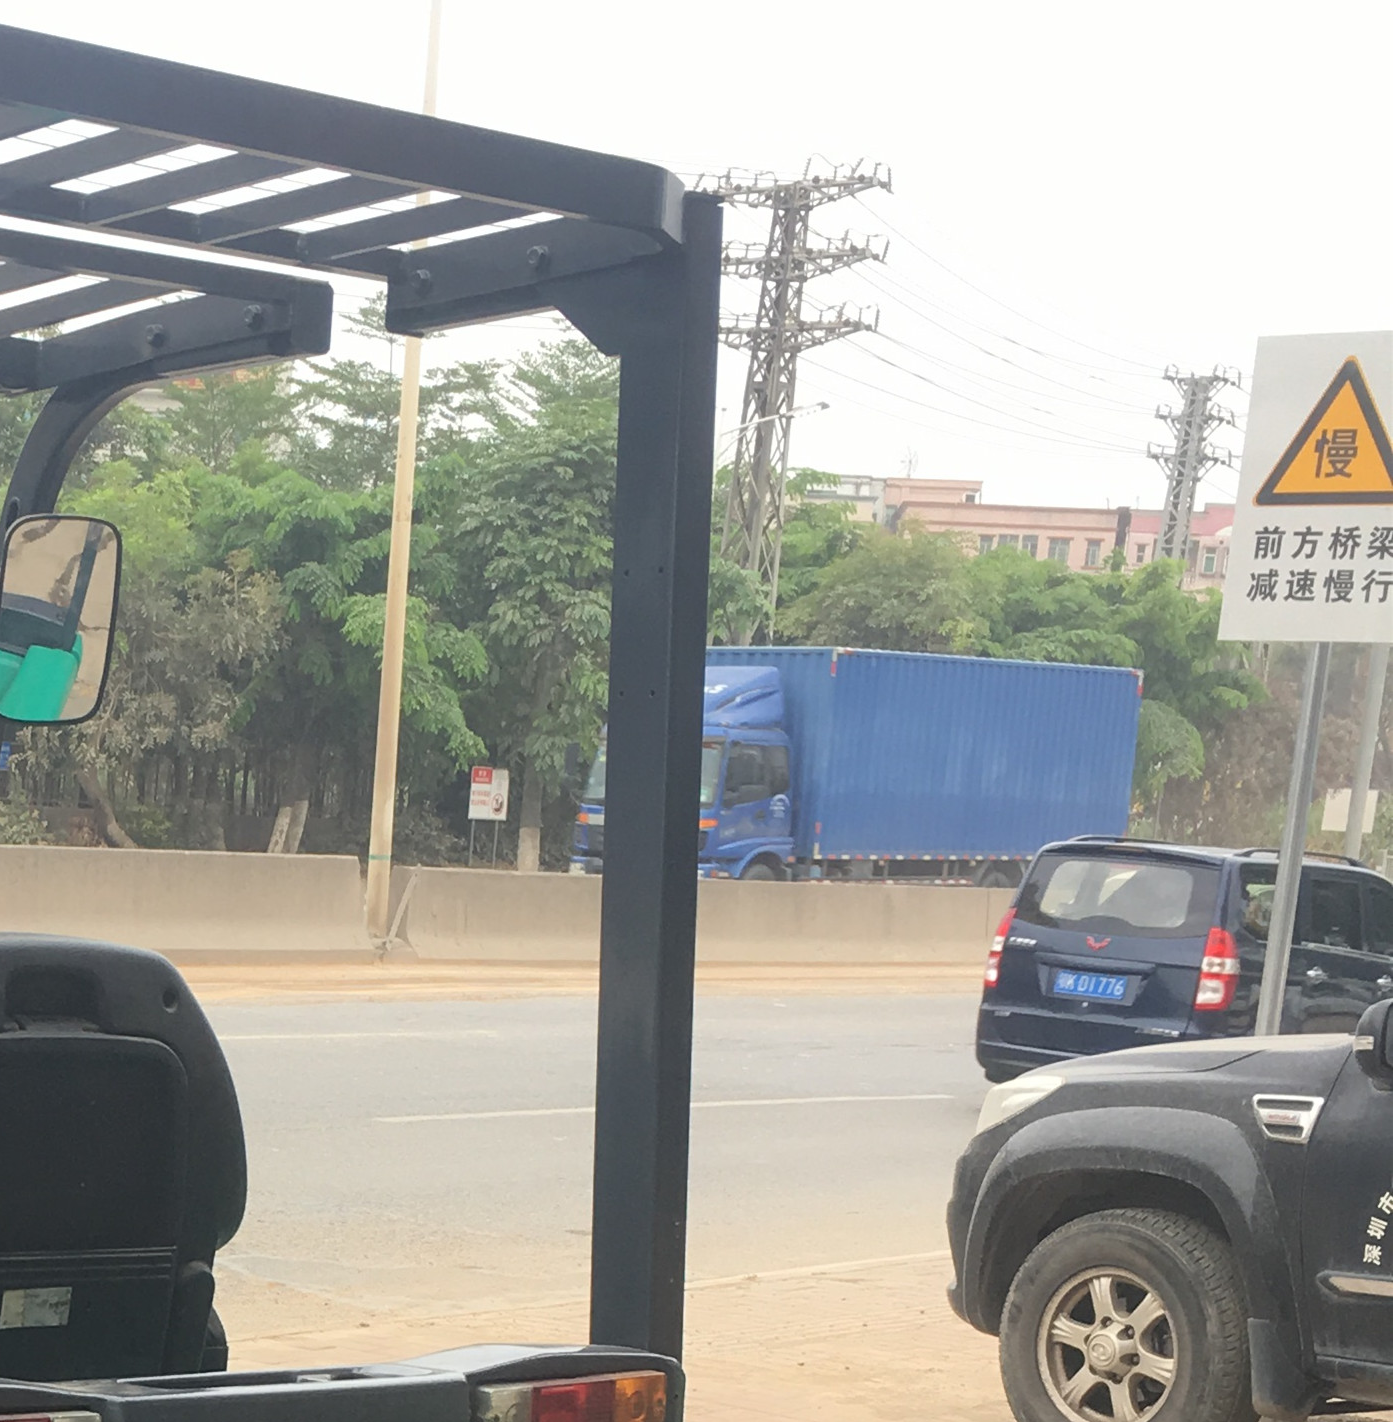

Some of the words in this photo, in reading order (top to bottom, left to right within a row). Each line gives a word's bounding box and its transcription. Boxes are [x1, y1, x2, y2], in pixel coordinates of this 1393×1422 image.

[1314, 429, 1358, 478] 慢
[1254, 525, 1393, 560] 前方桥梁
[1246, 568, 1393, 604] 减速慢行
